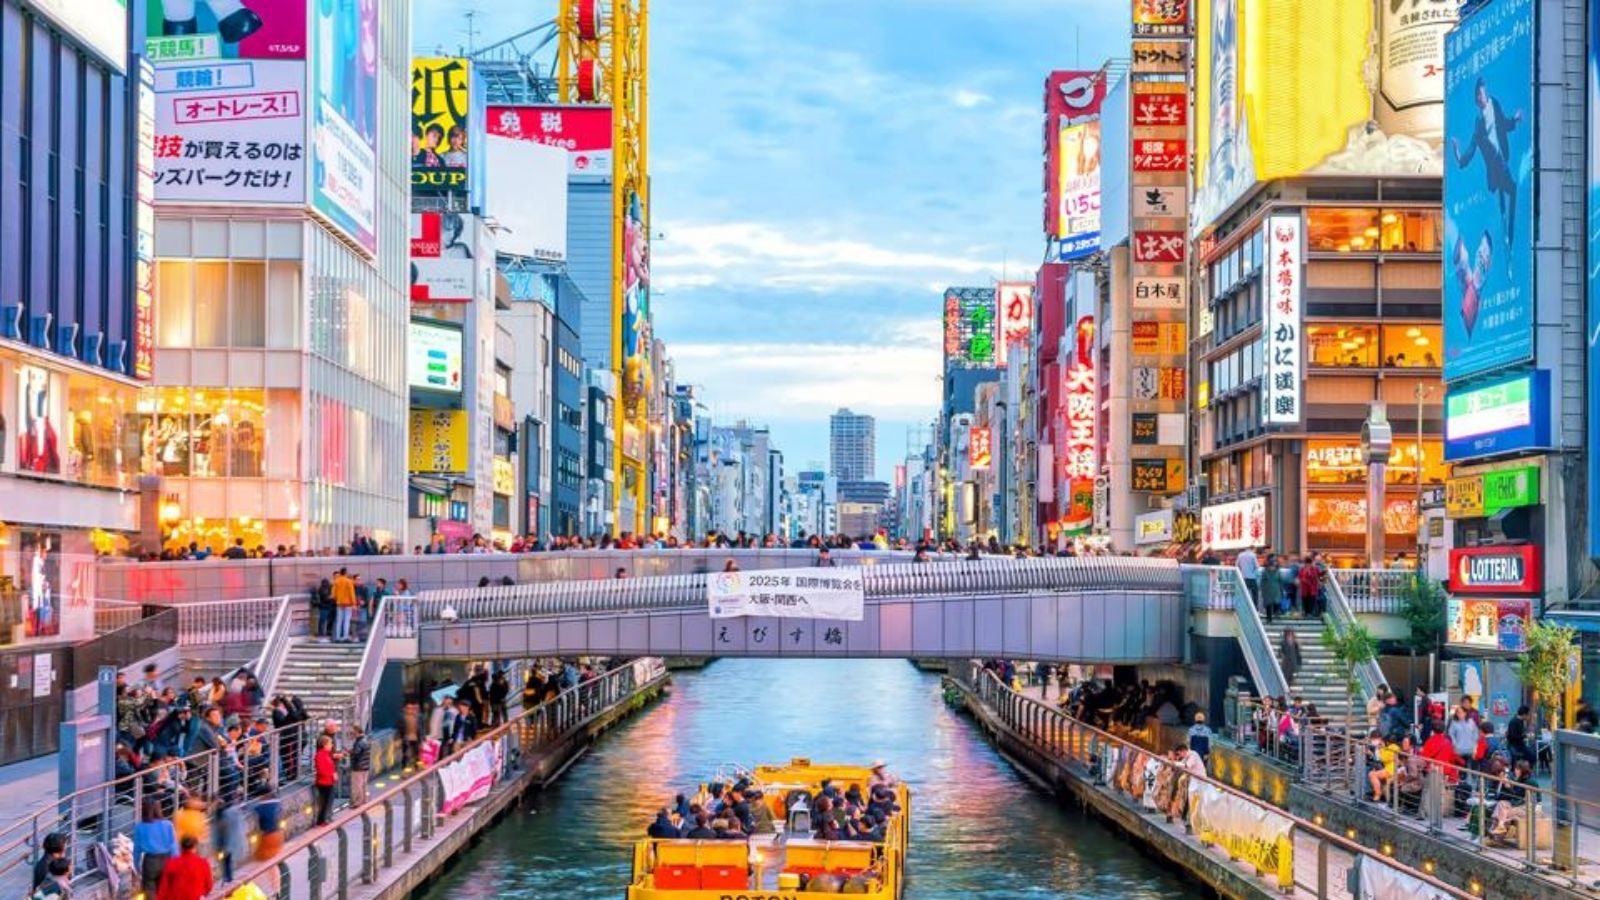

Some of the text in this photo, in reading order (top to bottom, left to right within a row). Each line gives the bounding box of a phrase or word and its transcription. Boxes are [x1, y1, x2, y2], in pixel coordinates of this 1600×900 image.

[186, 96, 288, 118] オートレース！
[154, 135, 302, 161] 技が買えるのは
[1136, 281, 1182, 303] 白木屋
[1276, 250, 1293, 315] 本場の味
[1471, 556, 1519, 581] LOTTERIA
[750, 576, 862, 590] 2025年 国際博覧会を
[718, 627, 842, 645] えびす橋
